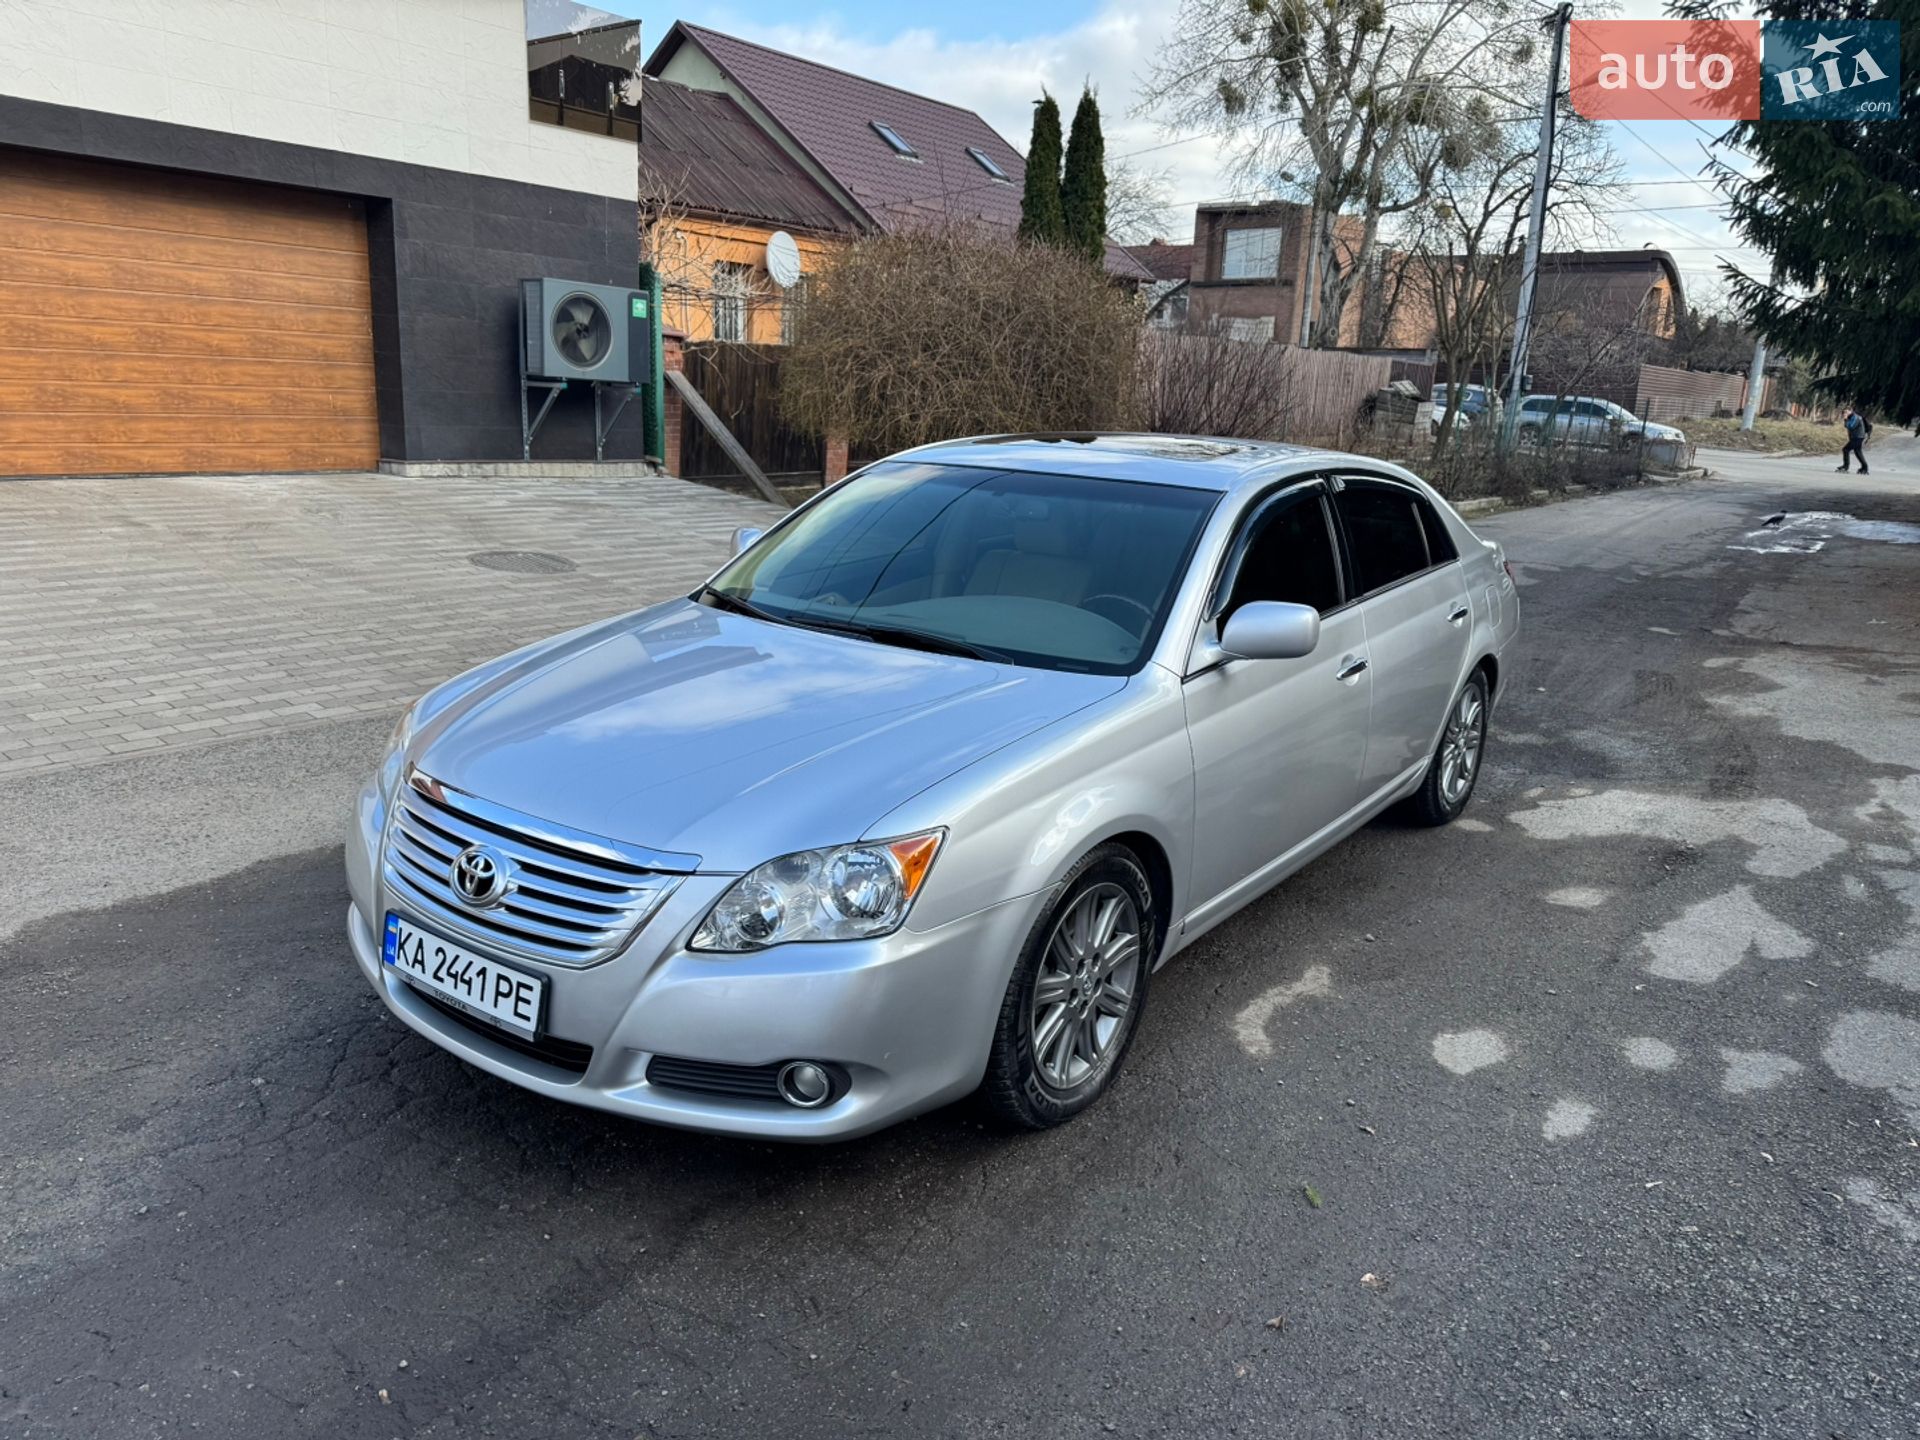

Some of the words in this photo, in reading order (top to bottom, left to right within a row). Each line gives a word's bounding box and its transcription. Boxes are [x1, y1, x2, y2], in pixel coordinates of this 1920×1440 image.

[396, 926, 426, 974] KA
[432, 947, 487, 1002] 2441
[493, 973, 534, 1022] PE
